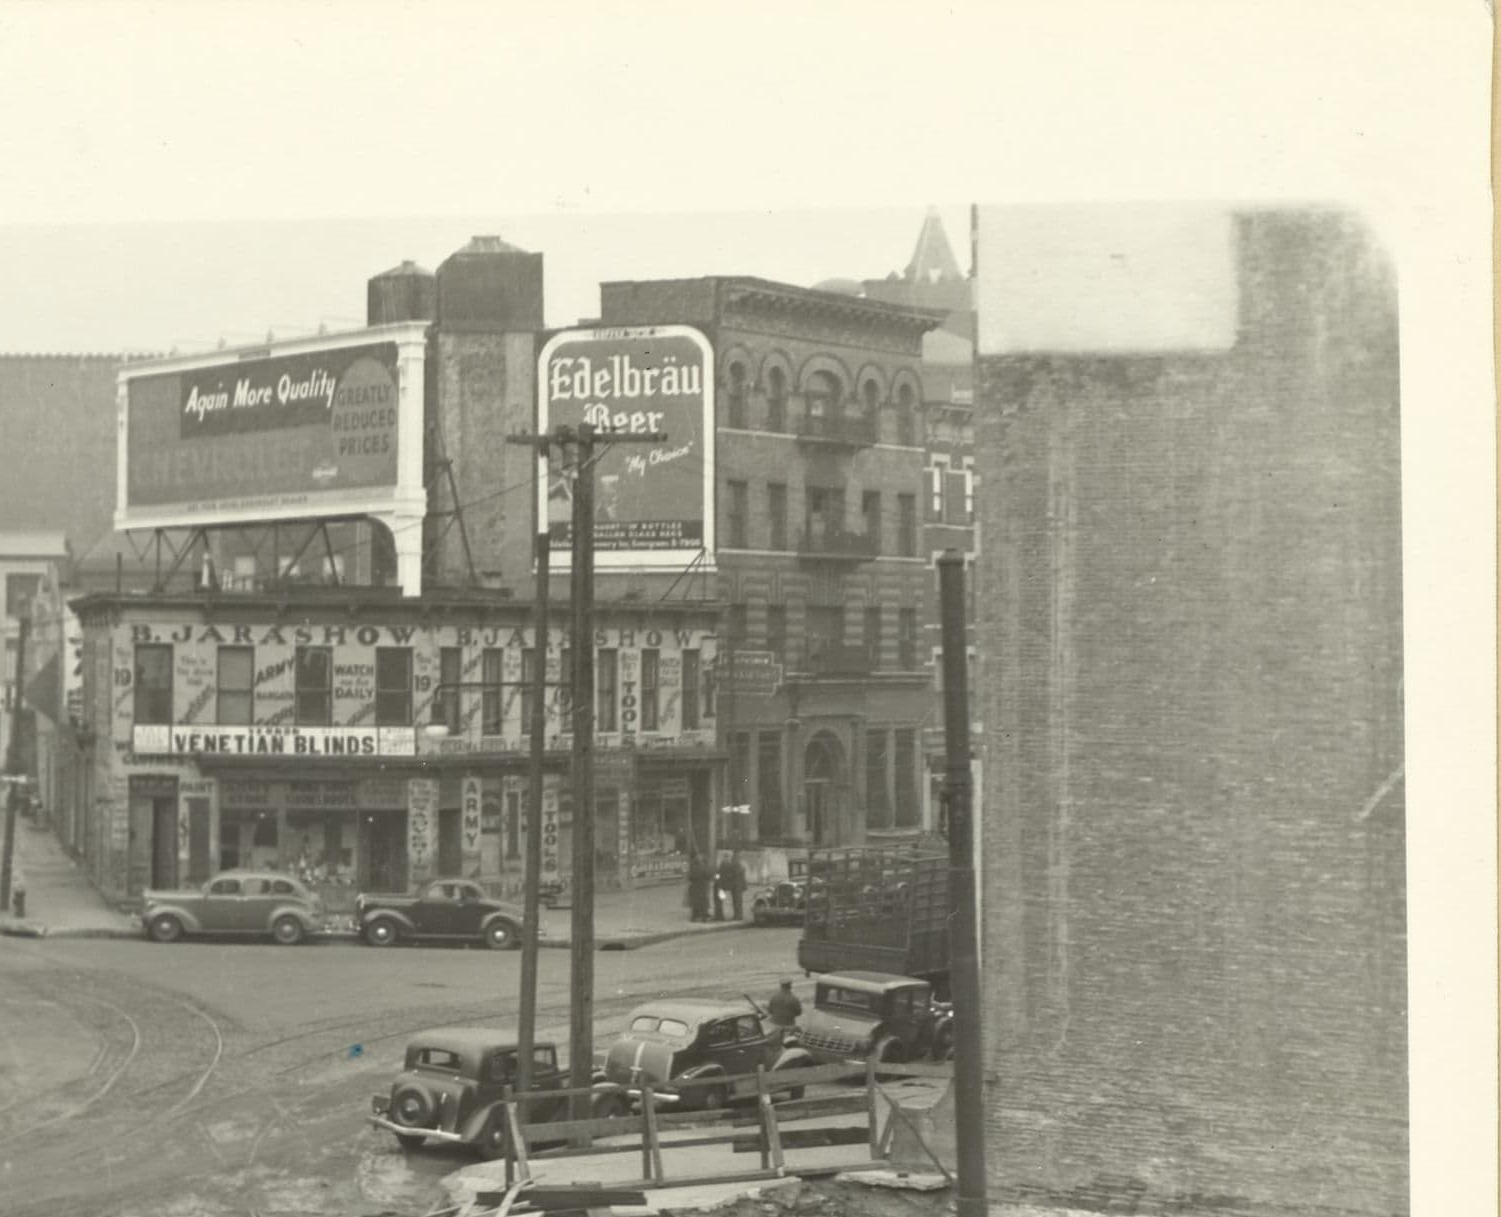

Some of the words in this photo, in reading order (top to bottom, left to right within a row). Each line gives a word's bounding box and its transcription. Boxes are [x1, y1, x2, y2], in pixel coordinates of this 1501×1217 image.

[549, 355, 702, 401] Edelbräu
[184, 382, 229, 422] Again
[232, 378, 274, 408] More
[277, 367, 336, 409] Quality
[338, 383, 390, 407] GREATLY
[582, 401, 665, 434] Beer
[338, 433, 390, 456] PRICES
[131, 625, 162, 643] B.
[170, 624, 417, 647] JARASHOW
[456, 628, 478, 647] B.
[115, 667, 132, 686] 19
[255, 656, 293, 685] ARMY
[333, 664, 374, 677] WATCH
[334, 687, 373, 700] DAILY
[414, 674, 431, 692] 19
[621, 681, 637, 748] TOOLS
[174, 734, 285, 755] VENETIAN
[294, 736, 375, 755] BLINDS
[465, 780, 479, 849] ARMY
[543, 811, 558, 873] TOOLS
